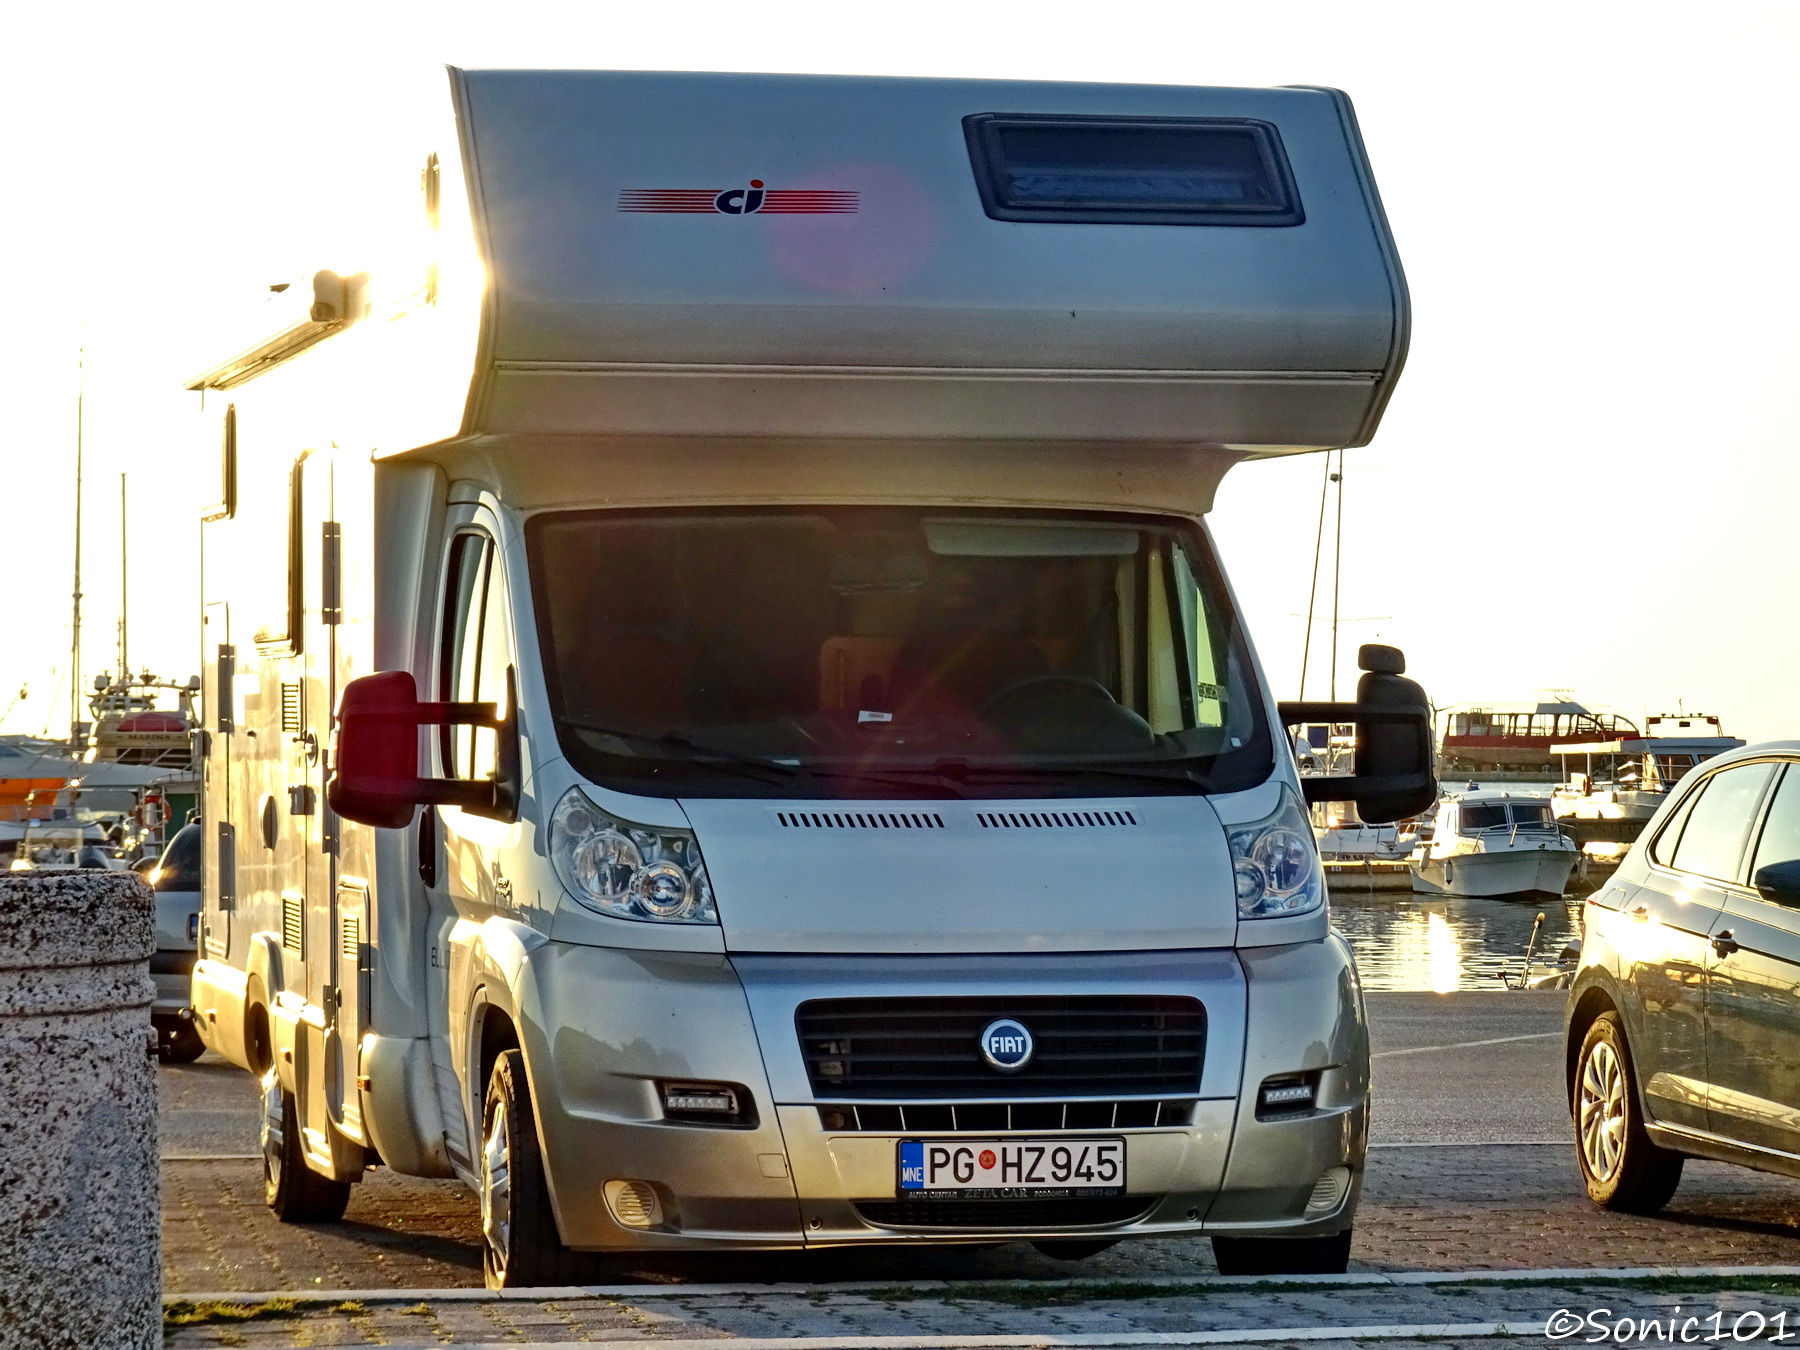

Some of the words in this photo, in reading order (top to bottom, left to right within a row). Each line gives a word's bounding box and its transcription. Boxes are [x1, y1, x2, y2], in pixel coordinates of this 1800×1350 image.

[990, 1036, 1024, 1053] FIAT
[929, 1147, 974, 1184] PG
[1001, 1146, 1118, 1183] HZ945
[902, 1167, 924, 1182] MNE
[908, 1190, 928, 1199] AUTO
[929, 1190, 958, 1199] CENTAR
[964, 1188, 998, 1199] ZETA
[1001, 1187, 1028, 1198] CAR
